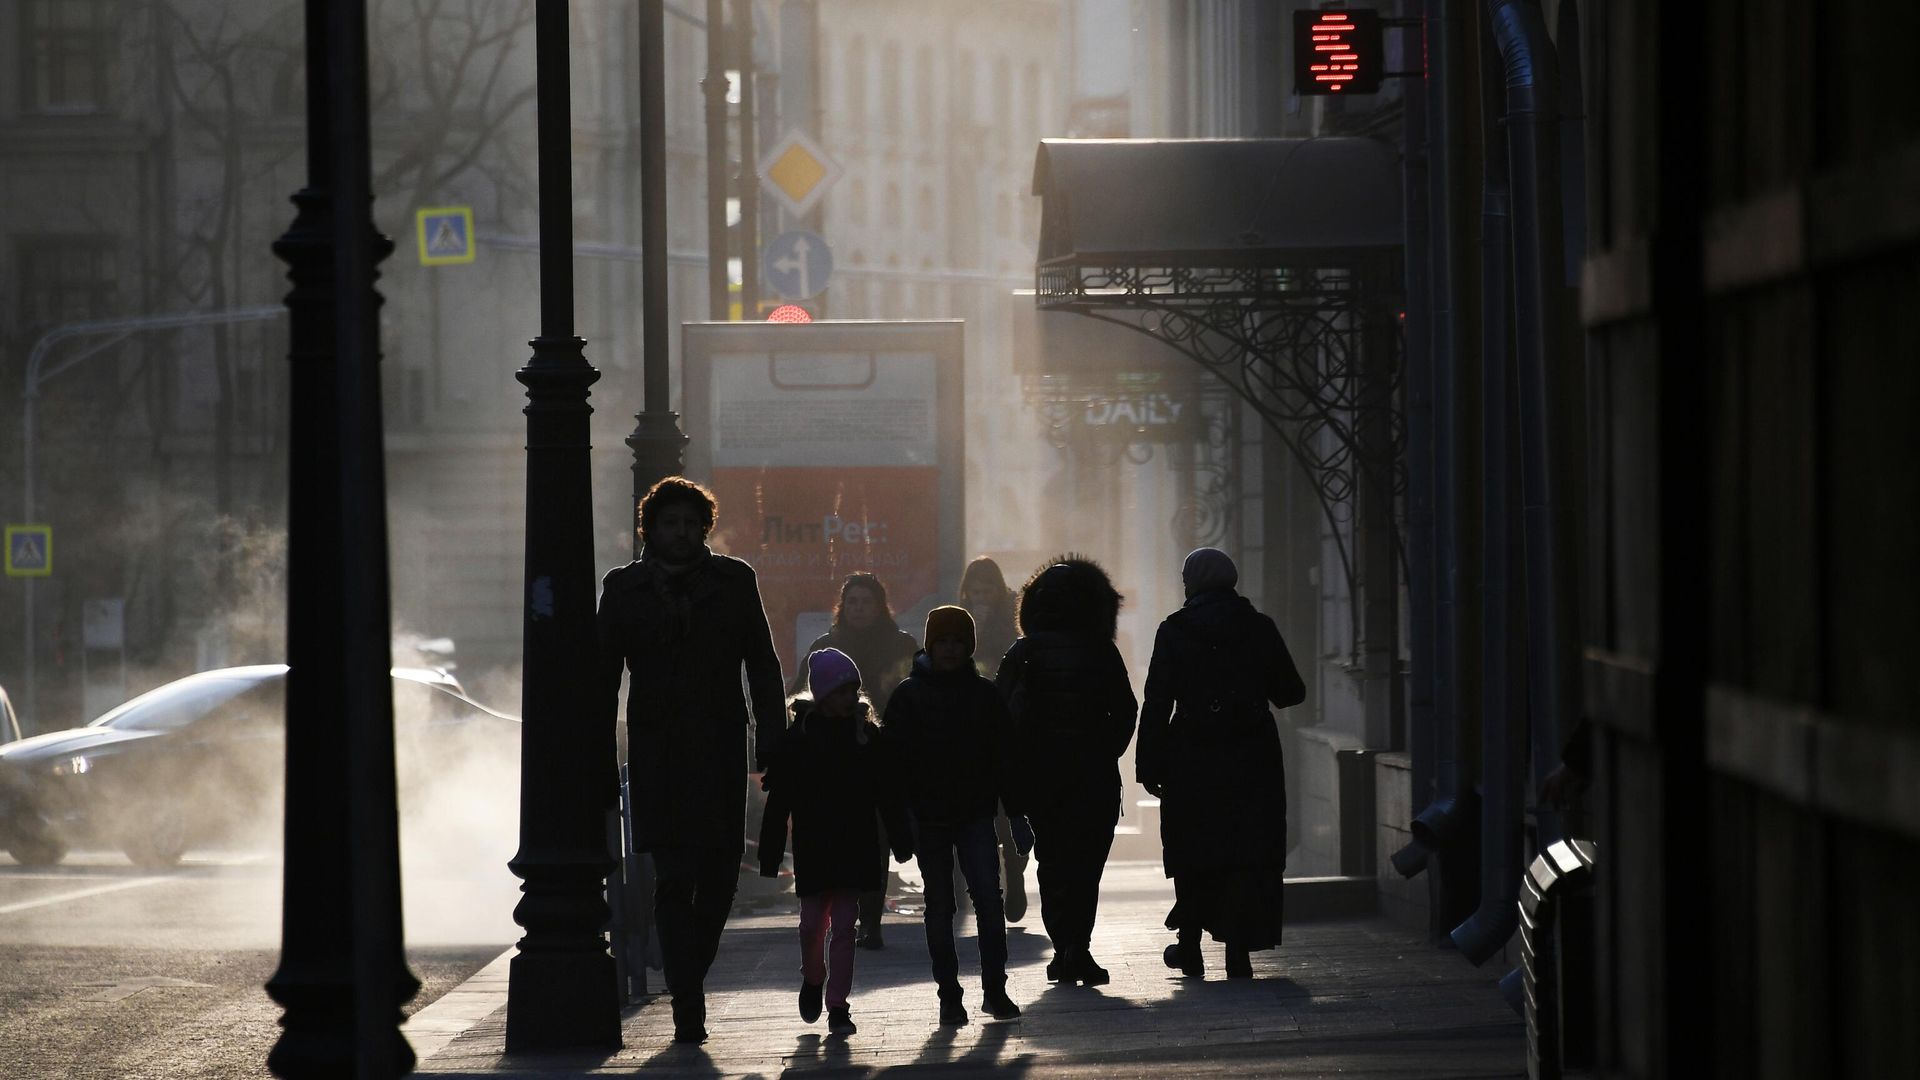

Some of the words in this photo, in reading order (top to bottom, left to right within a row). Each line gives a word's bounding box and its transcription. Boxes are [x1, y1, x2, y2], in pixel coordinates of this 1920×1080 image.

[1086, 393, 1183, 424] DAILY
[763, 516, 888, 544] ЛитРес:
[828, 550, 908, 566] ЛУШАЙ
